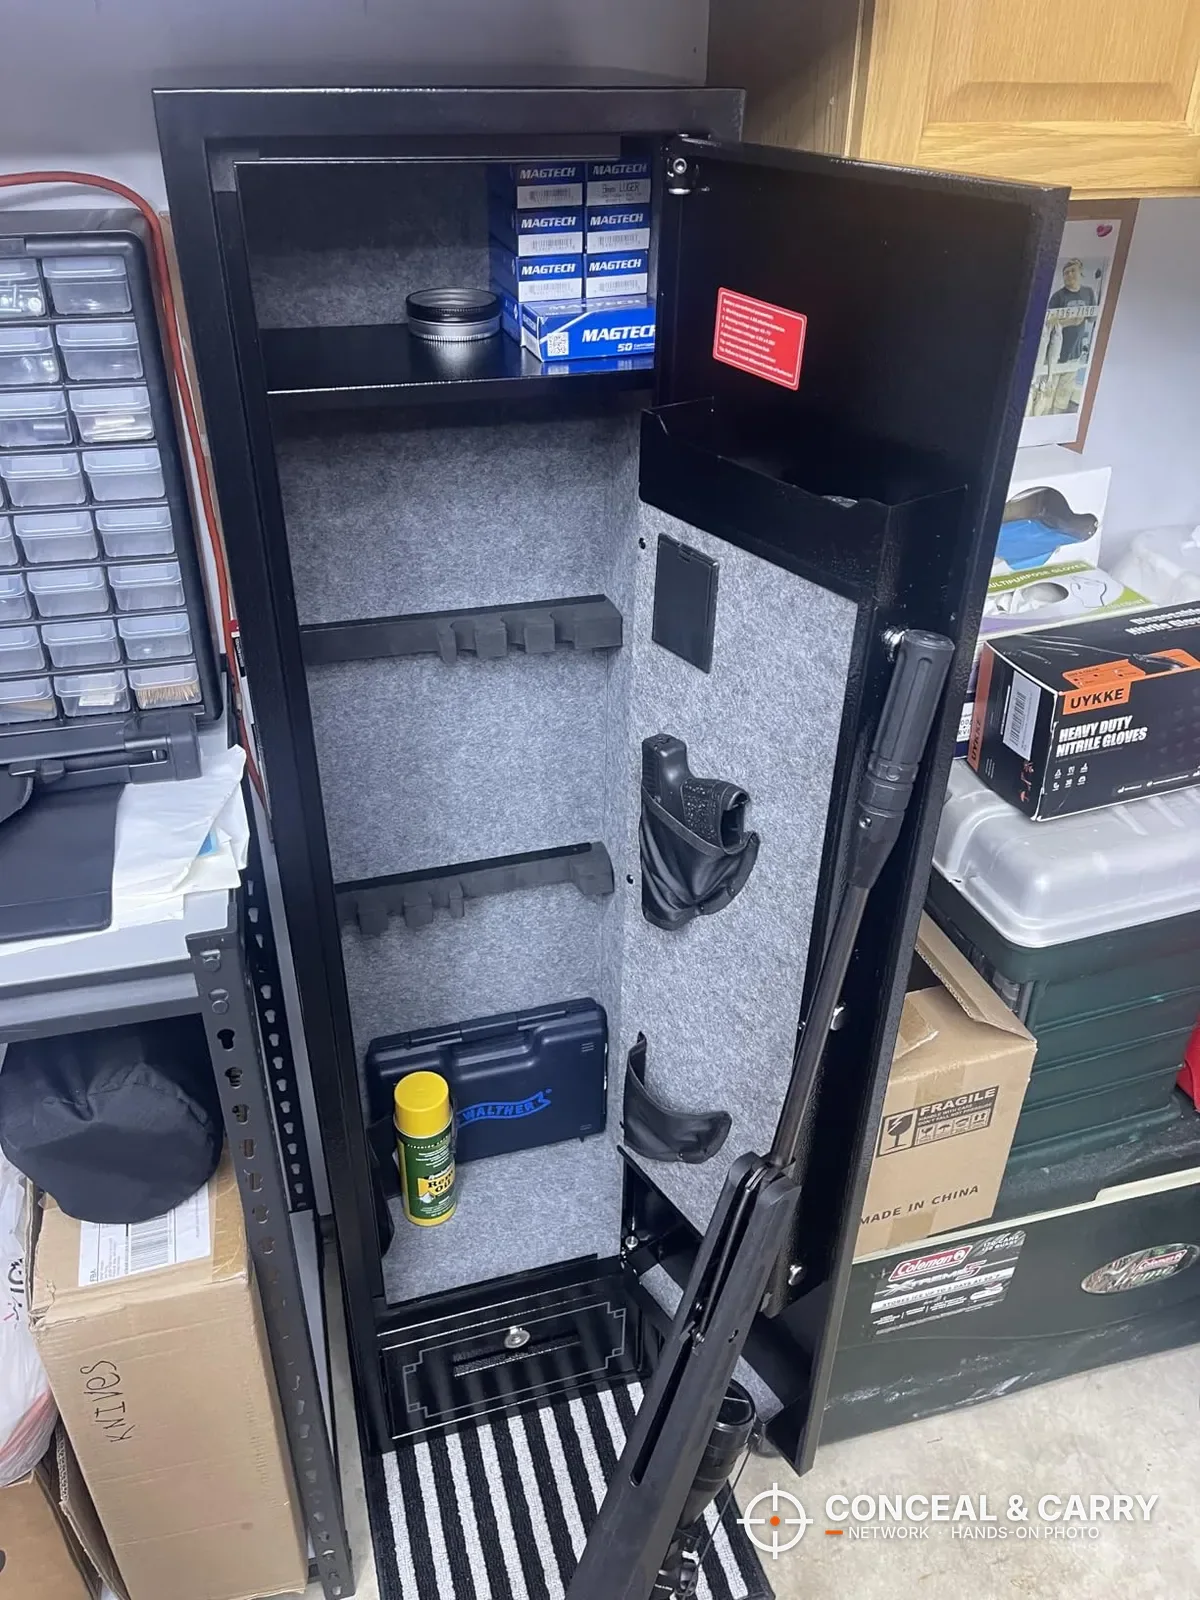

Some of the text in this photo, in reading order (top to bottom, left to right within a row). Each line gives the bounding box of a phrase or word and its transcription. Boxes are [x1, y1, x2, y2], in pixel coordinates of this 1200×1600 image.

[520, 167, 576, 179] MAGTECH
[593, 163, 647, 175] MAGTECH
[521, 216, 576, 228] MAGTECH
[590, 213, 644, 226] MAGTECH
[522, 263, 576, 275] MAGTECH
[589, 259, 641, 272] MAGTECH
[617, 343, 632, 352] 50
[1125, 622, 1172, 635] Nitrile
[1070, 688, 1124, 709] UYKKE
[1058, 715, 1133, 743] HEAVY DUTY
[1056, 736, 1102, 758] NITRILE
[1102, 727, 1148, 748] GLOVES
[919, 1088, 996, 1117] FRAGILE
[463, 1101, 534, 1120] WALTHER
[861, 1185, 978, 1225] MADE IN CHINA
[898, 1254, 951, 1276] Coleman
